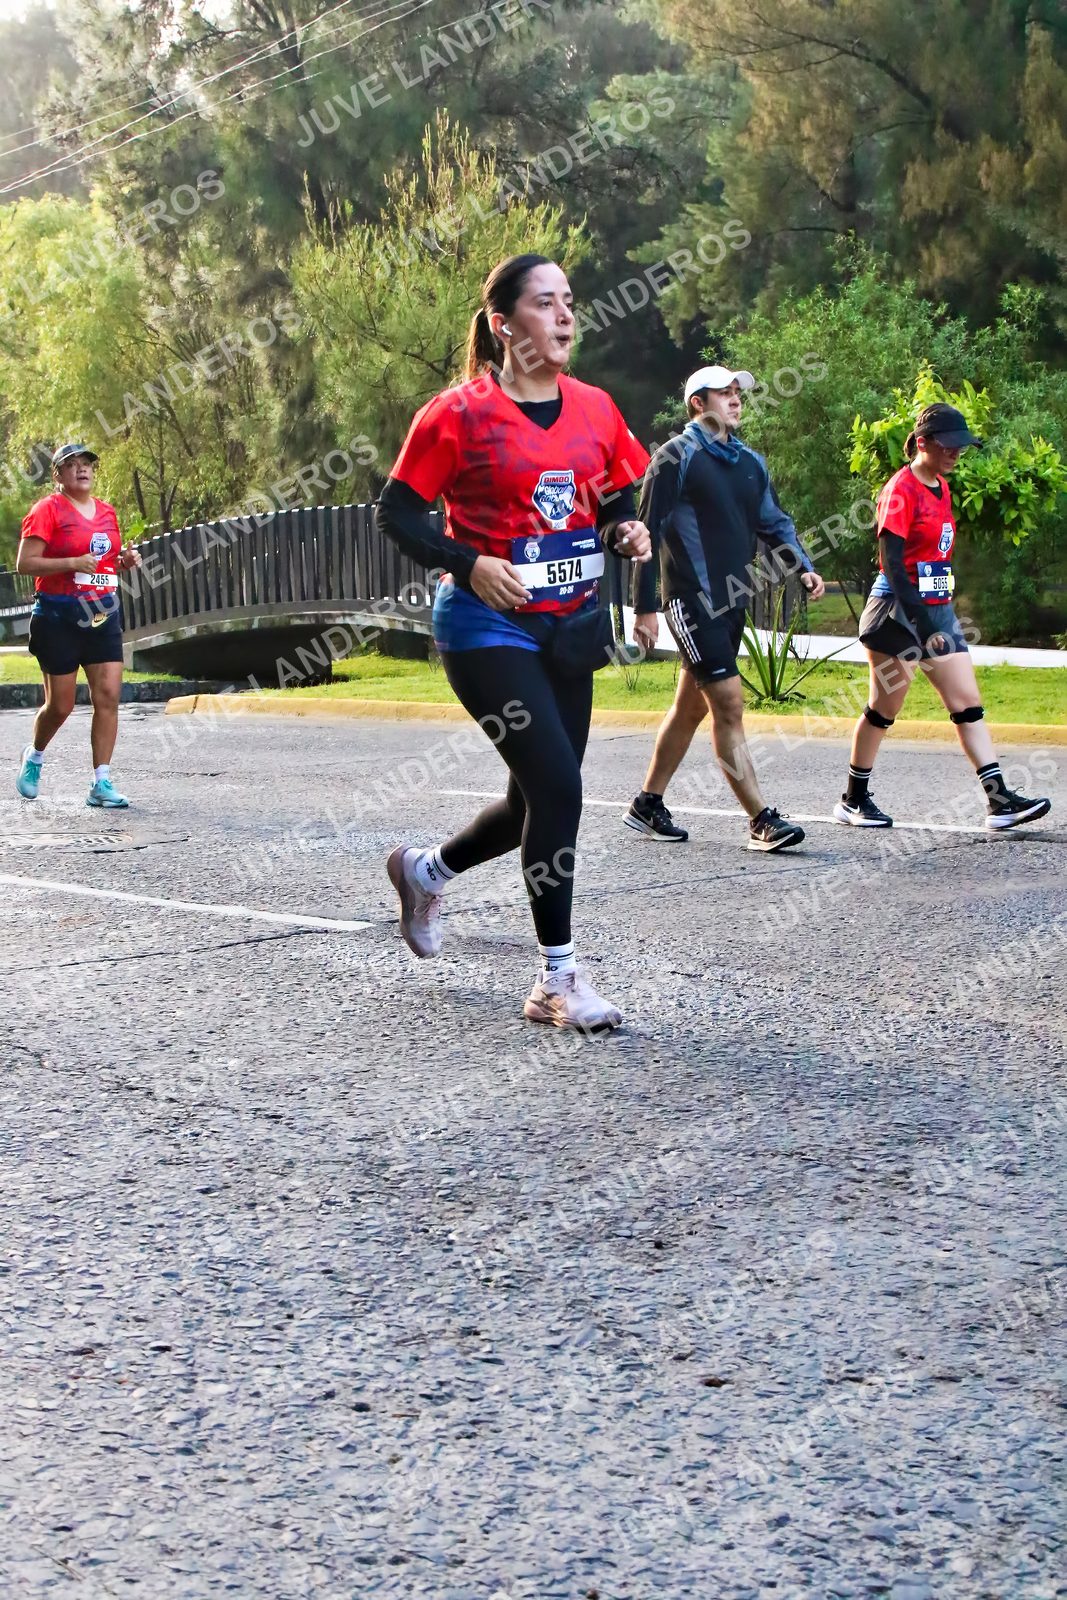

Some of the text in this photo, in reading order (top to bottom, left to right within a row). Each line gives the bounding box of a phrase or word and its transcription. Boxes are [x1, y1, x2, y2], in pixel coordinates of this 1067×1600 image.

[90, 574, 110, 585] 2455
[547, 559, 583, 585] 5574
[426, 862, 437, 881] alo
